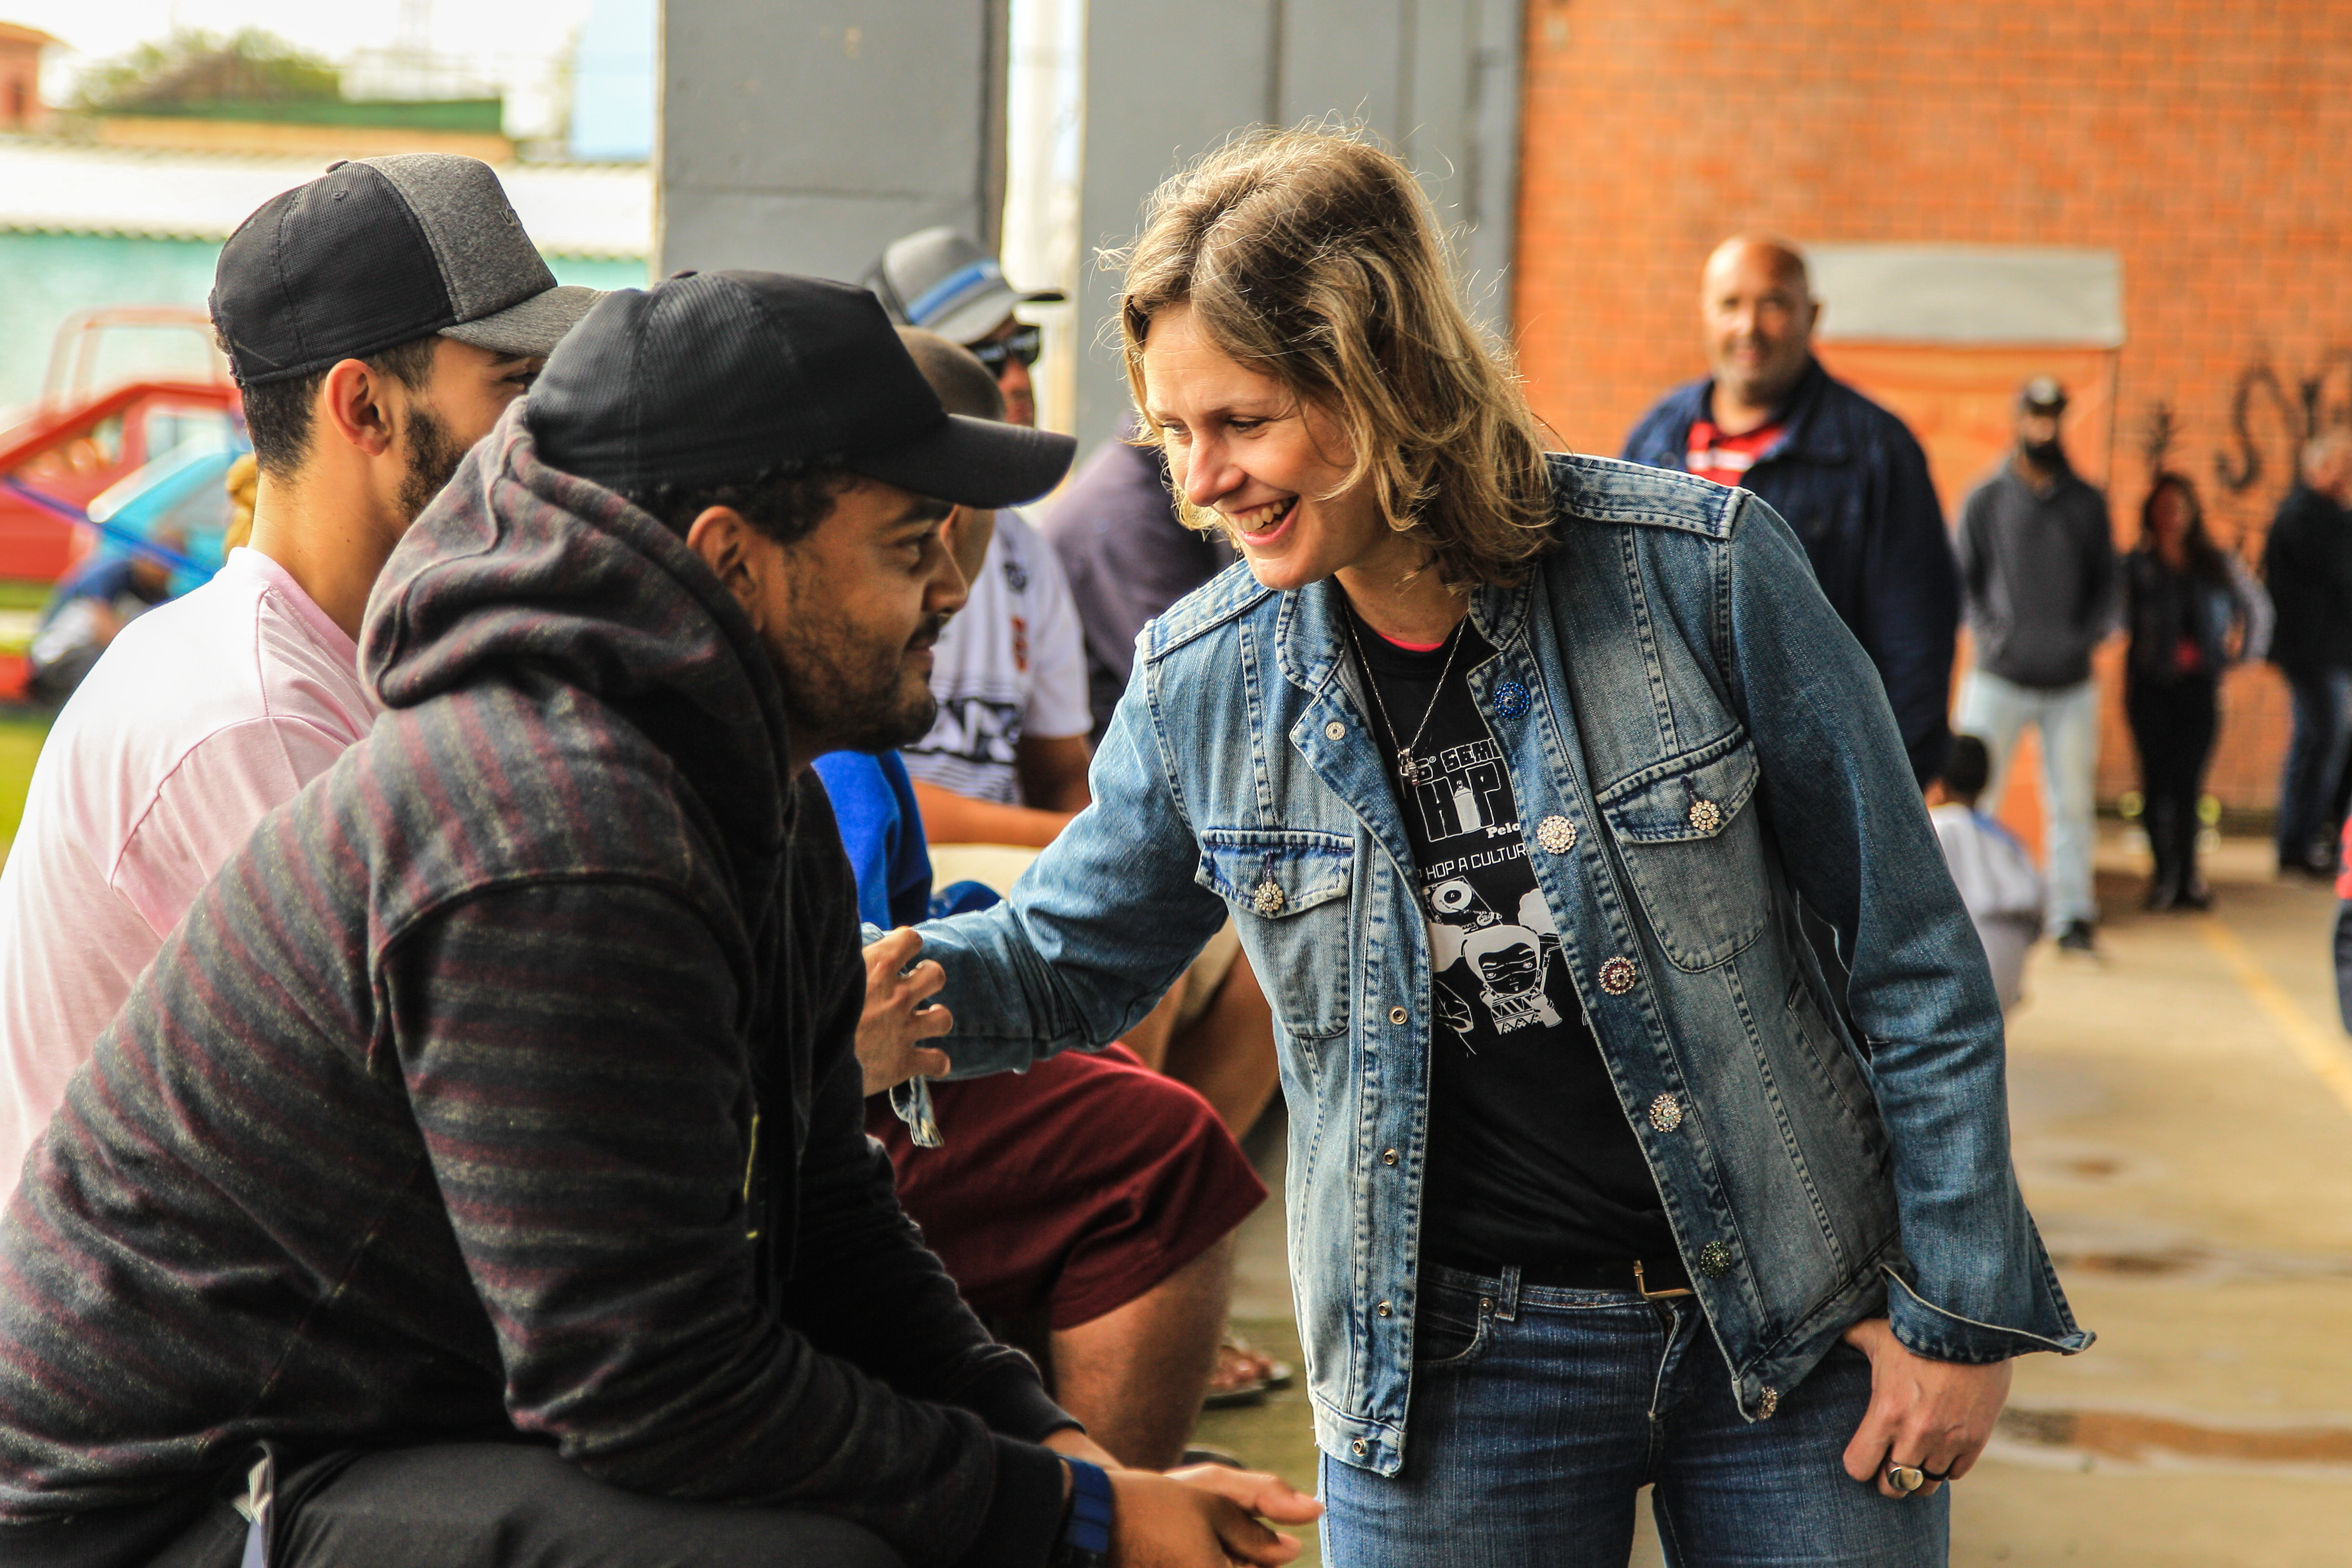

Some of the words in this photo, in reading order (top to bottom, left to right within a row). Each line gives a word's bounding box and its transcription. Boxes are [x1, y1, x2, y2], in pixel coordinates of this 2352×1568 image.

[1486, 822, 1521, 839] Pelo
[1426, 860, 1455, 880] HOP
[1458, 857, 1469, 872] A
[1470, 843, 1527, 869] CULTUR
